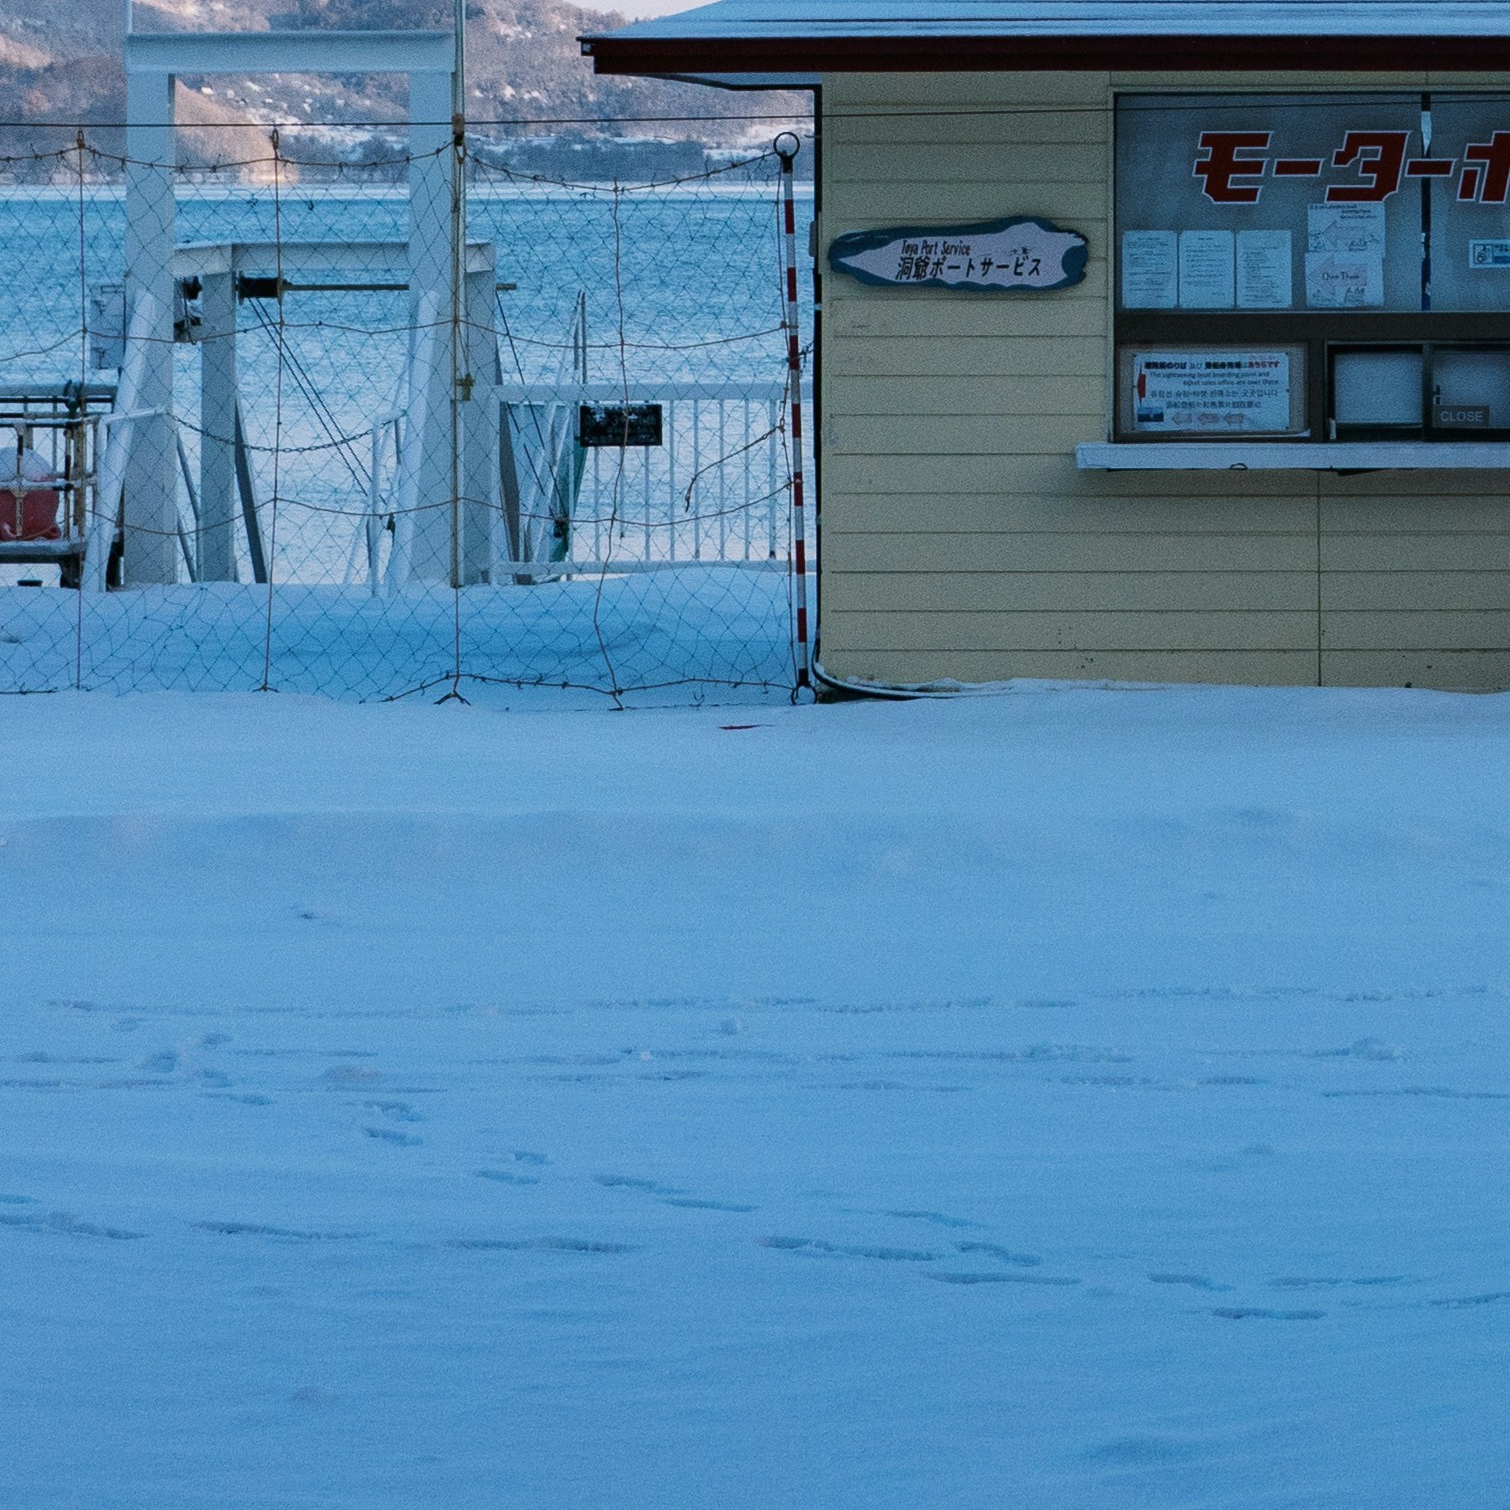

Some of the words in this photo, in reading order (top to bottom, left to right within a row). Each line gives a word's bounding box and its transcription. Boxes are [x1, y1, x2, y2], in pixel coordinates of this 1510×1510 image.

[901, 240, 919, 256] Toya
[921, 240, 939, 255] Port
[941, 240, 971, 256] Service
[1440, 410, 1484, 422] CLOSE
